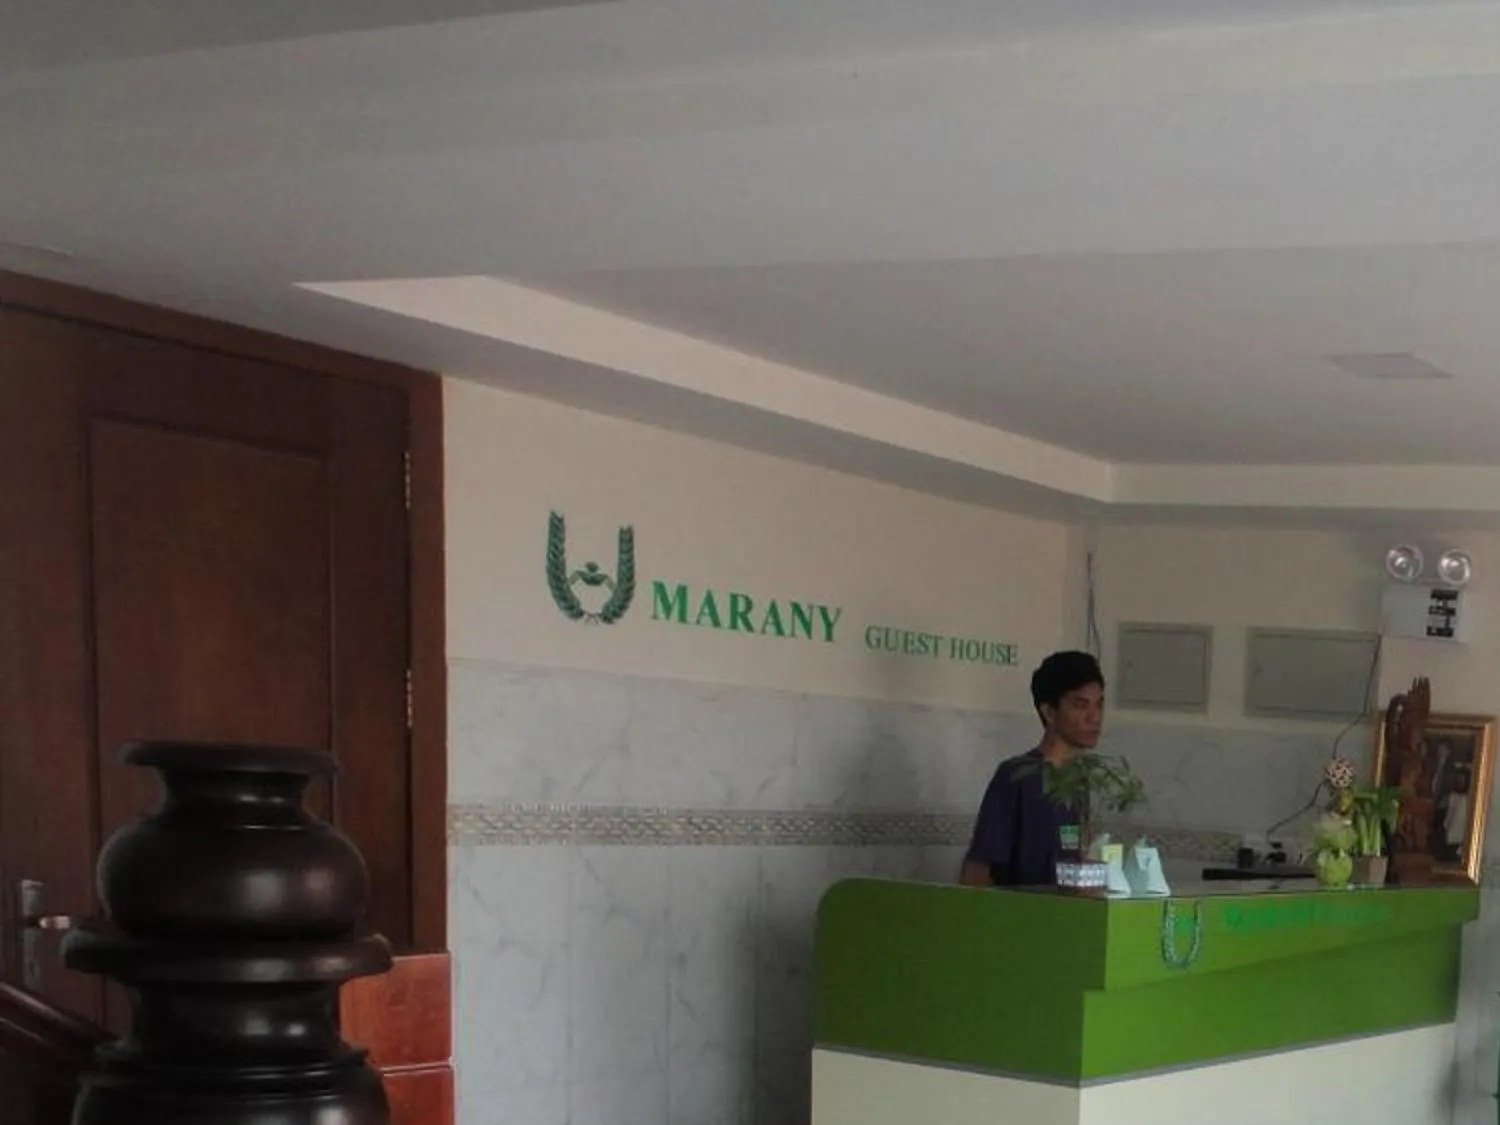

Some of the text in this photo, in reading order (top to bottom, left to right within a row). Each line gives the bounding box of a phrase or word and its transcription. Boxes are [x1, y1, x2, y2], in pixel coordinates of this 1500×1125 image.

[651, 580, 1018, 666] MARANY GUEST HOUSE
